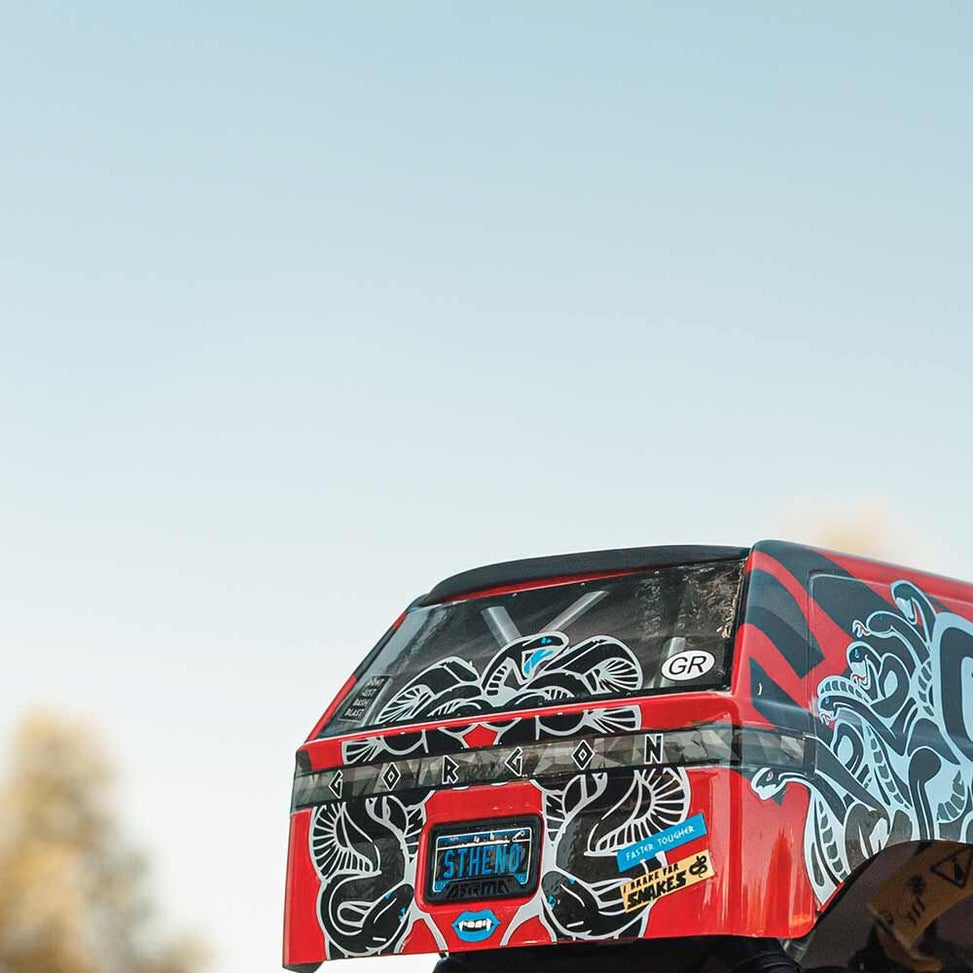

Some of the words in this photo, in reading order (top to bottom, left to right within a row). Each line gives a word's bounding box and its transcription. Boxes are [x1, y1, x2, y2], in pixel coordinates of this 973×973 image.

[669, 656, 706, 675] GR
[328, 733, 664, 799] GORGON
[626, 844, 654, 860] FASTER
[657, 826, 694, 846] TOUGHER
[443, 843, 521, 878] STHENO
[627, 870, 687, 908] SNAKES
[630, 871, 659, 890] BRAKE
